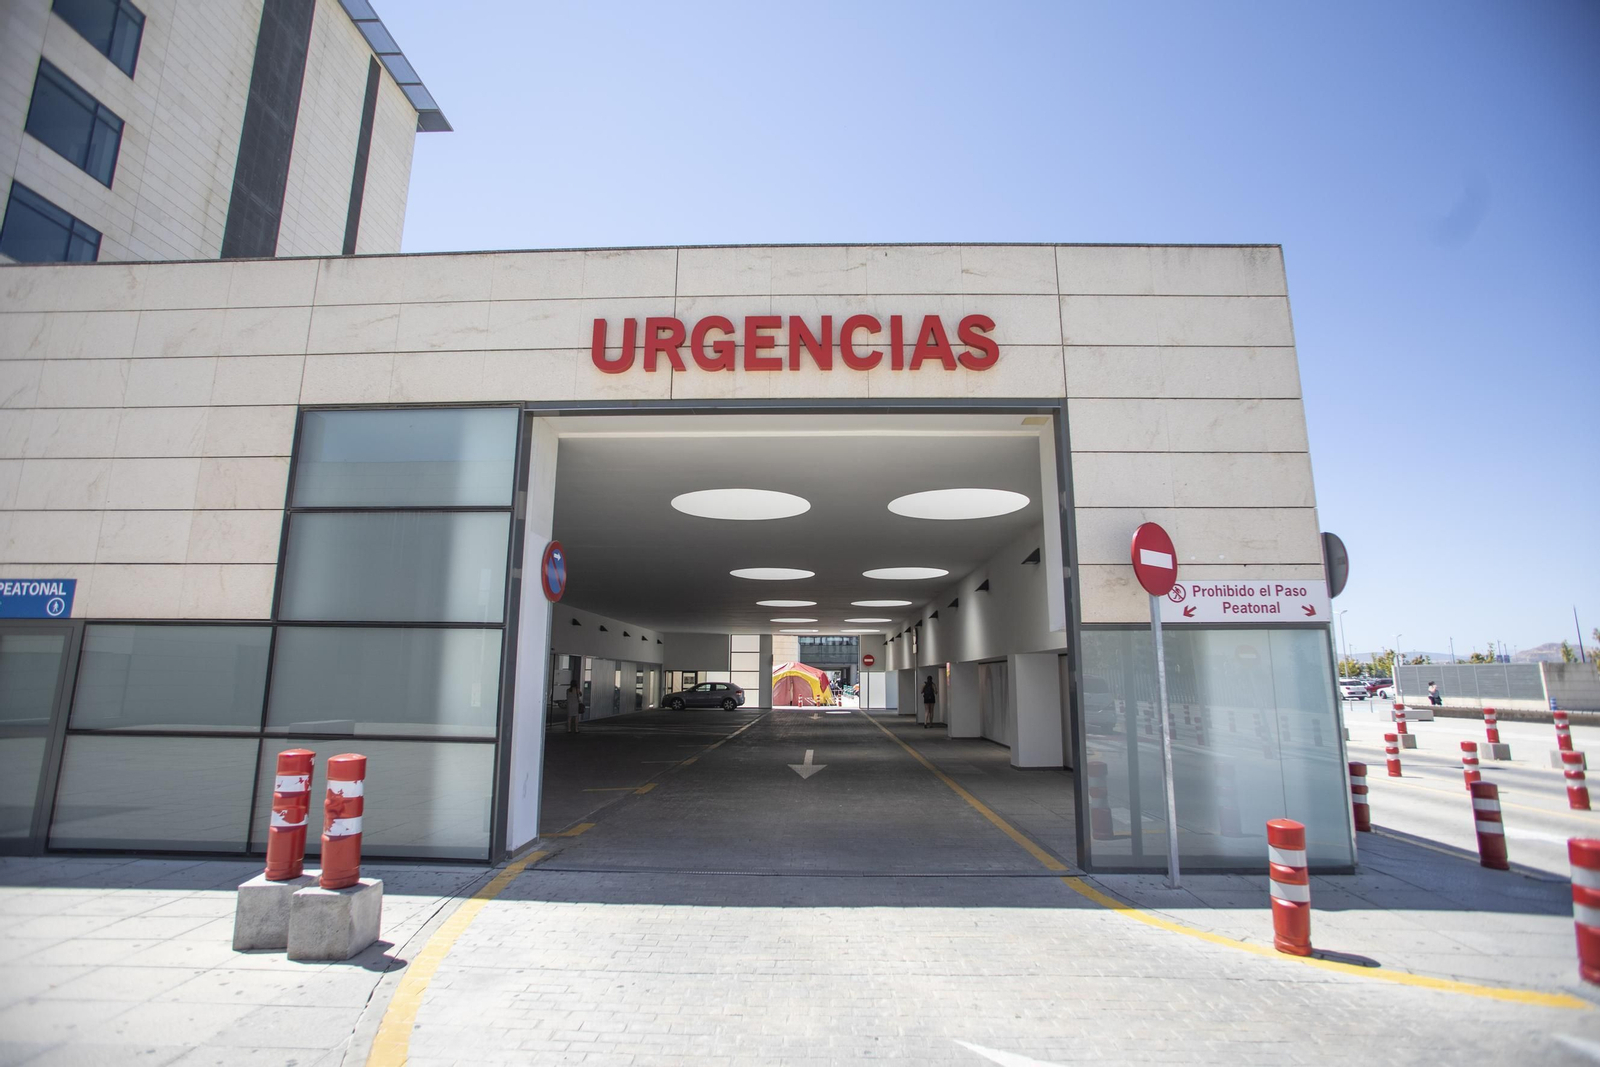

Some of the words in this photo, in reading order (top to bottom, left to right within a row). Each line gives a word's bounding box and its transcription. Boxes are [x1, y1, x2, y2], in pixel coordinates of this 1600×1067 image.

[591, 314, 1000, 374] URGENCIAS
[1192, 584, 1255, 597] Prohibido
[1259, 584, 1271, 597] el
[1275, 584, 1307, 597] Paso
[1222, 601, 1281, 614] Peatonal
